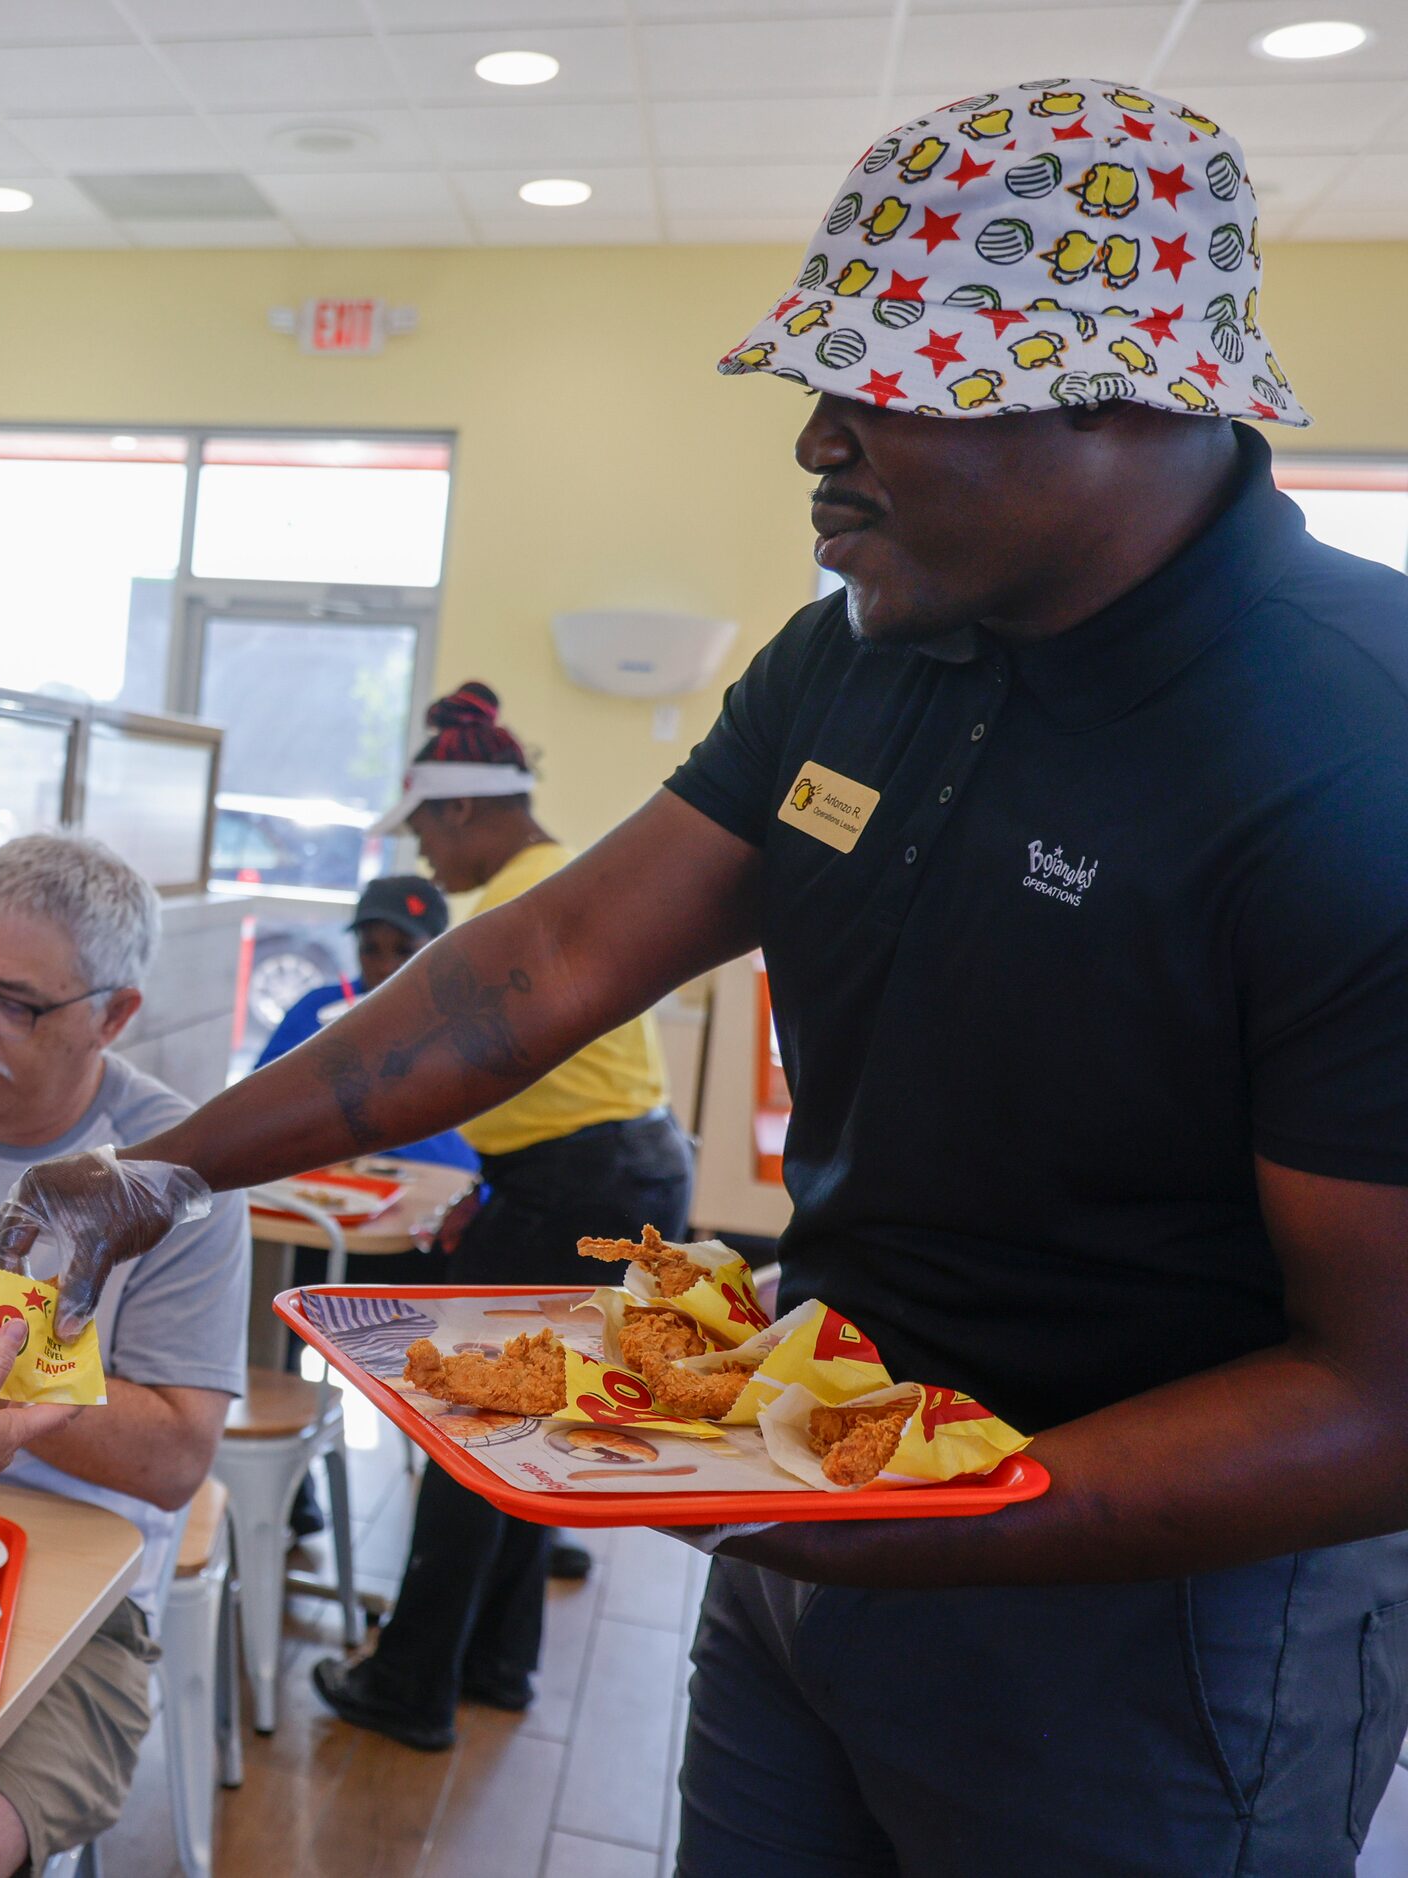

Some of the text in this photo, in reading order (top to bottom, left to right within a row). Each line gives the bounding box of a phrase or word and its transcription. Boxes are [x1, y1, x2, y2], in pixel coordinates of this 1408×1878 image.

[316, 302, 373, 350] EXIT
[823, 793, 852, 814] Arlonzo
[813, 806, 859, 834] Operations Leader
[1022, 875, 1082, 907] OPERATIONS
[44, 1345, 65, 1361] LEVEL
[46, 1336, 62, 1351] NEXT
[35, 1357, 76, 1375] FLAVOR
